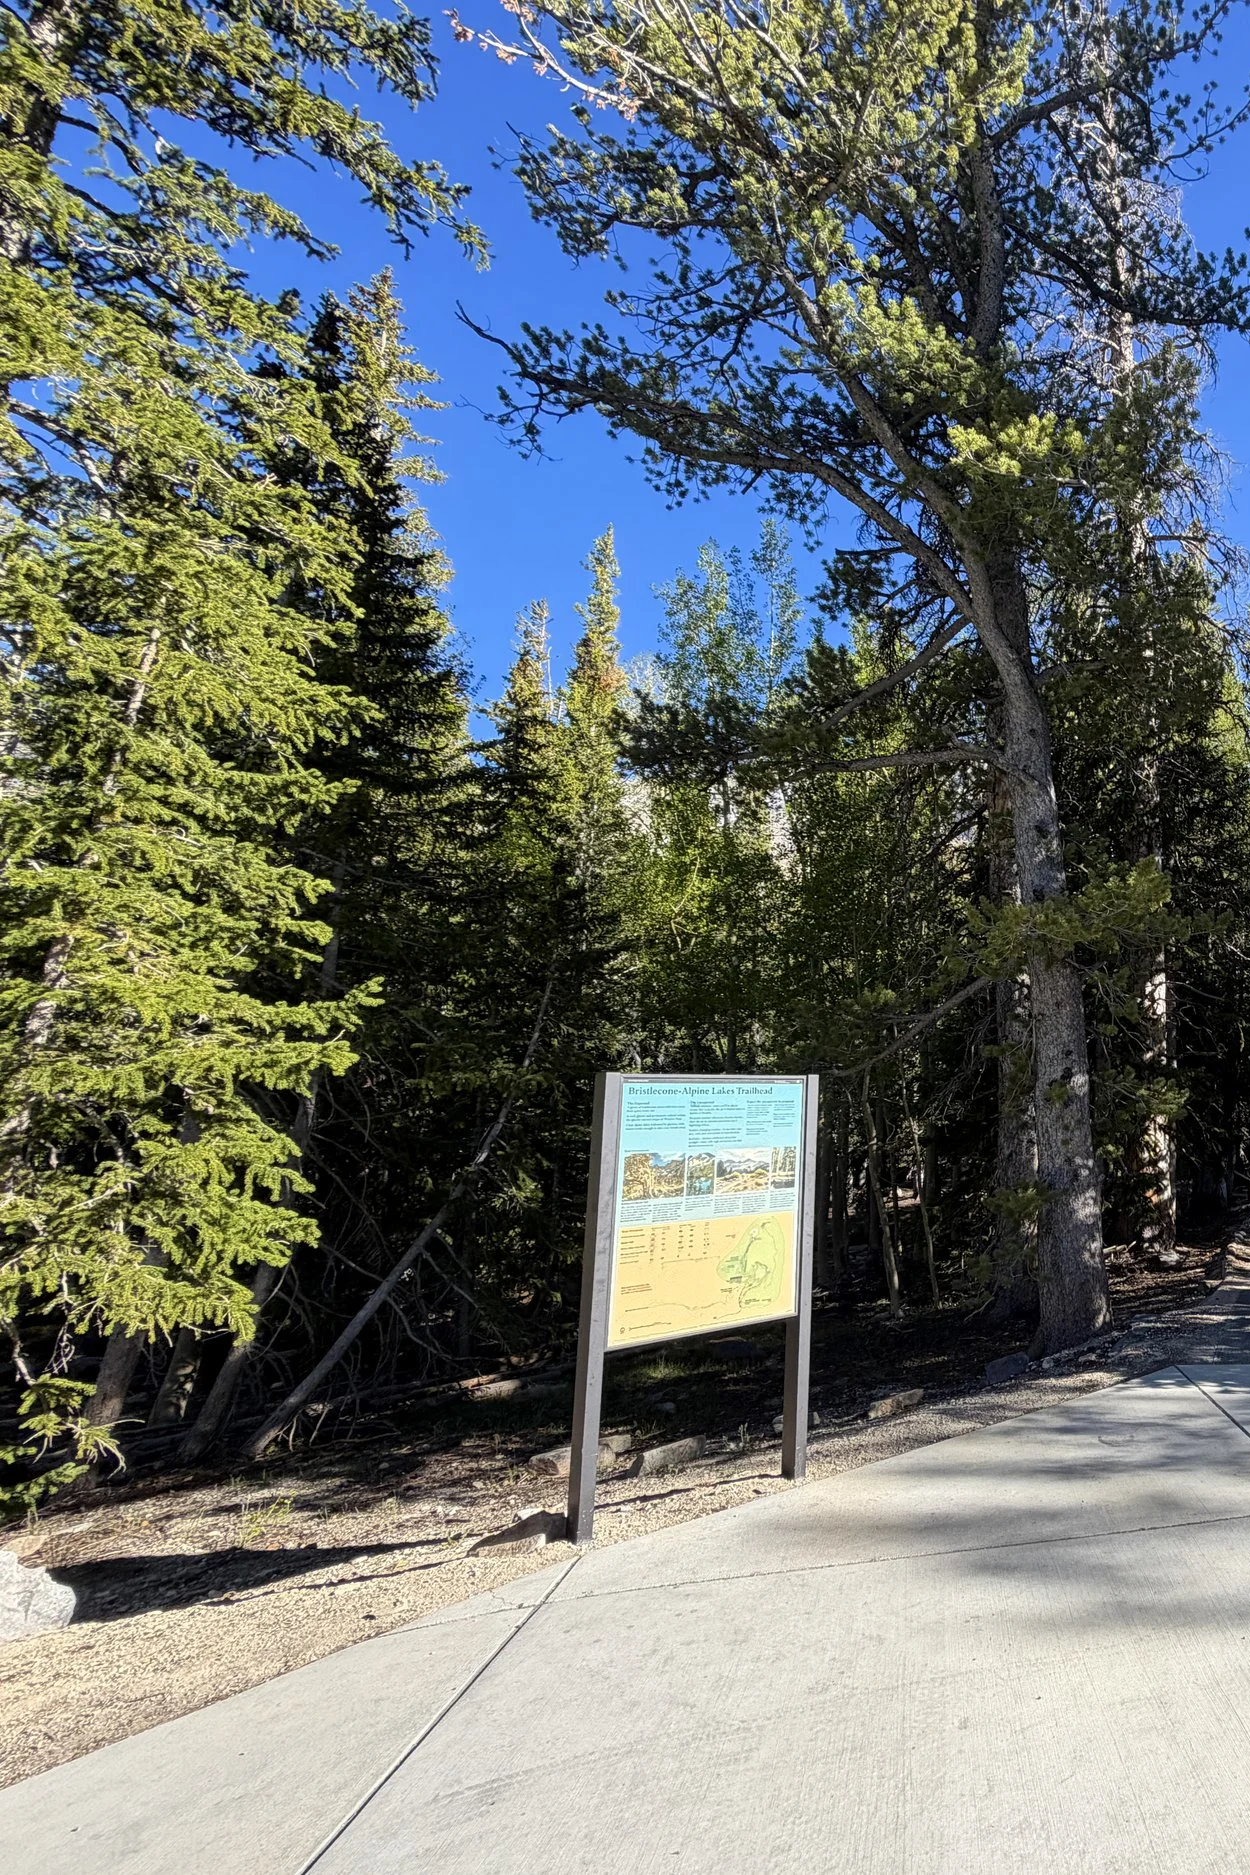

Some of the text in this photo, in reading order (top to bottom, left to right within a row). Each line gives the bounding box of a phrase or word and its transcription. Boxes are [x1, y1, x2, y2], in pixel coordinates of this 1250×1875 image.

[628, 1086, 773, 1097] Bristlecone-Alpine Lakes Trailhead
